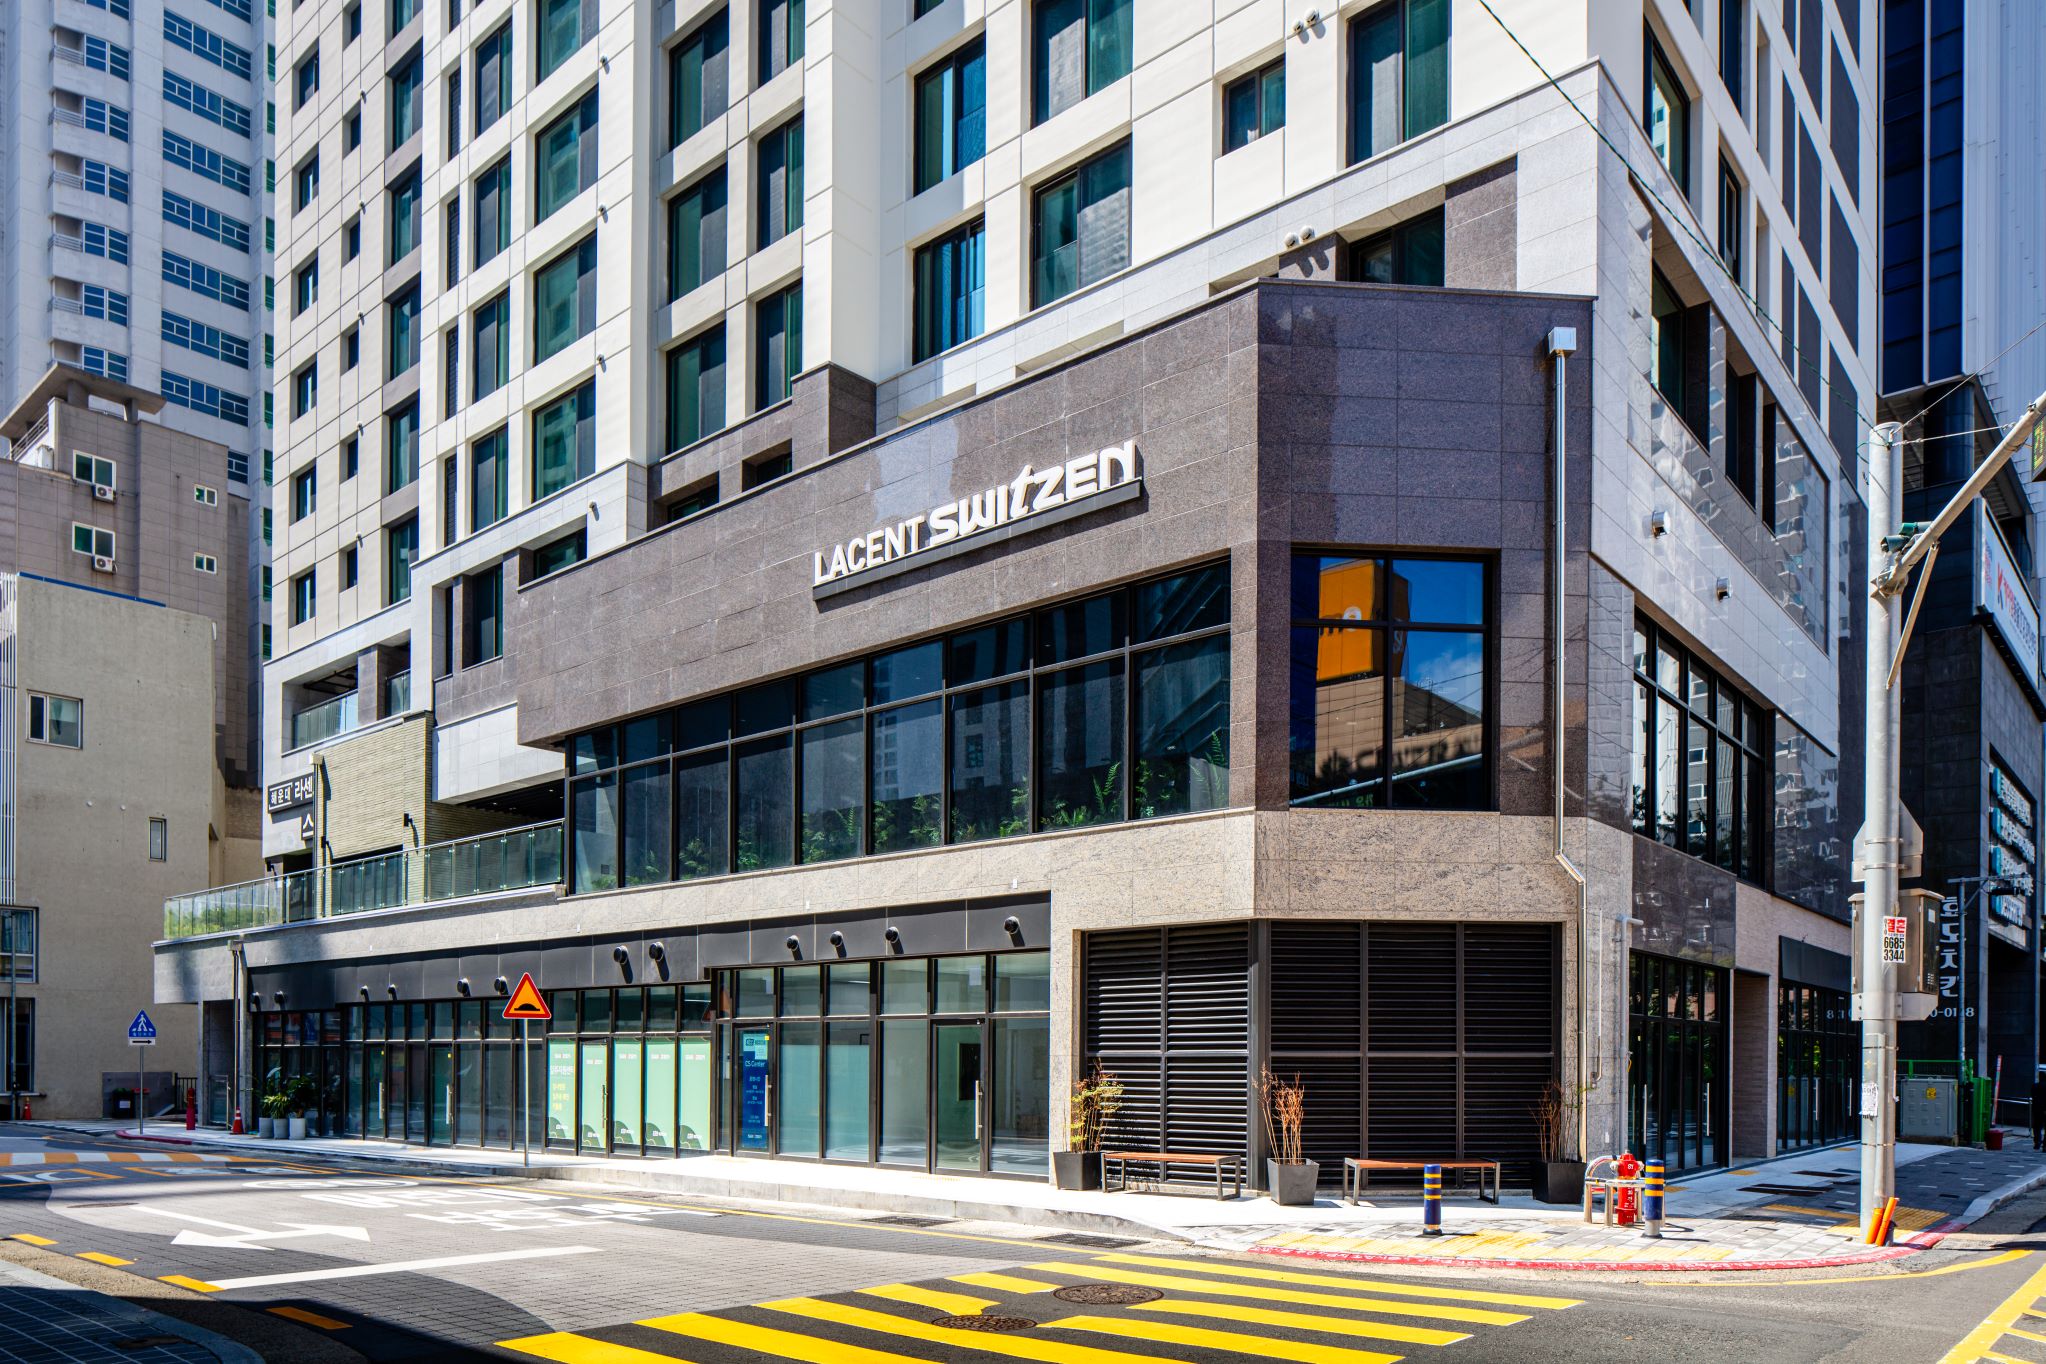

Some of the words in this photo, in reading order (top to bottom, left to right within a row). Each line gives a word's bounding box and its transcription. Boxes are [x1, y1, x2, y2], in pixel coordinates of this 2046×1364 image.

[814, 515, 925, 585] LACENT
[270, 786, 291, 805] 해운대
[1887, 918, 1906, 934] 결혼
[1883, 937, 1905, 949] 6685
[1883, 949, 1905, 961] 3344
